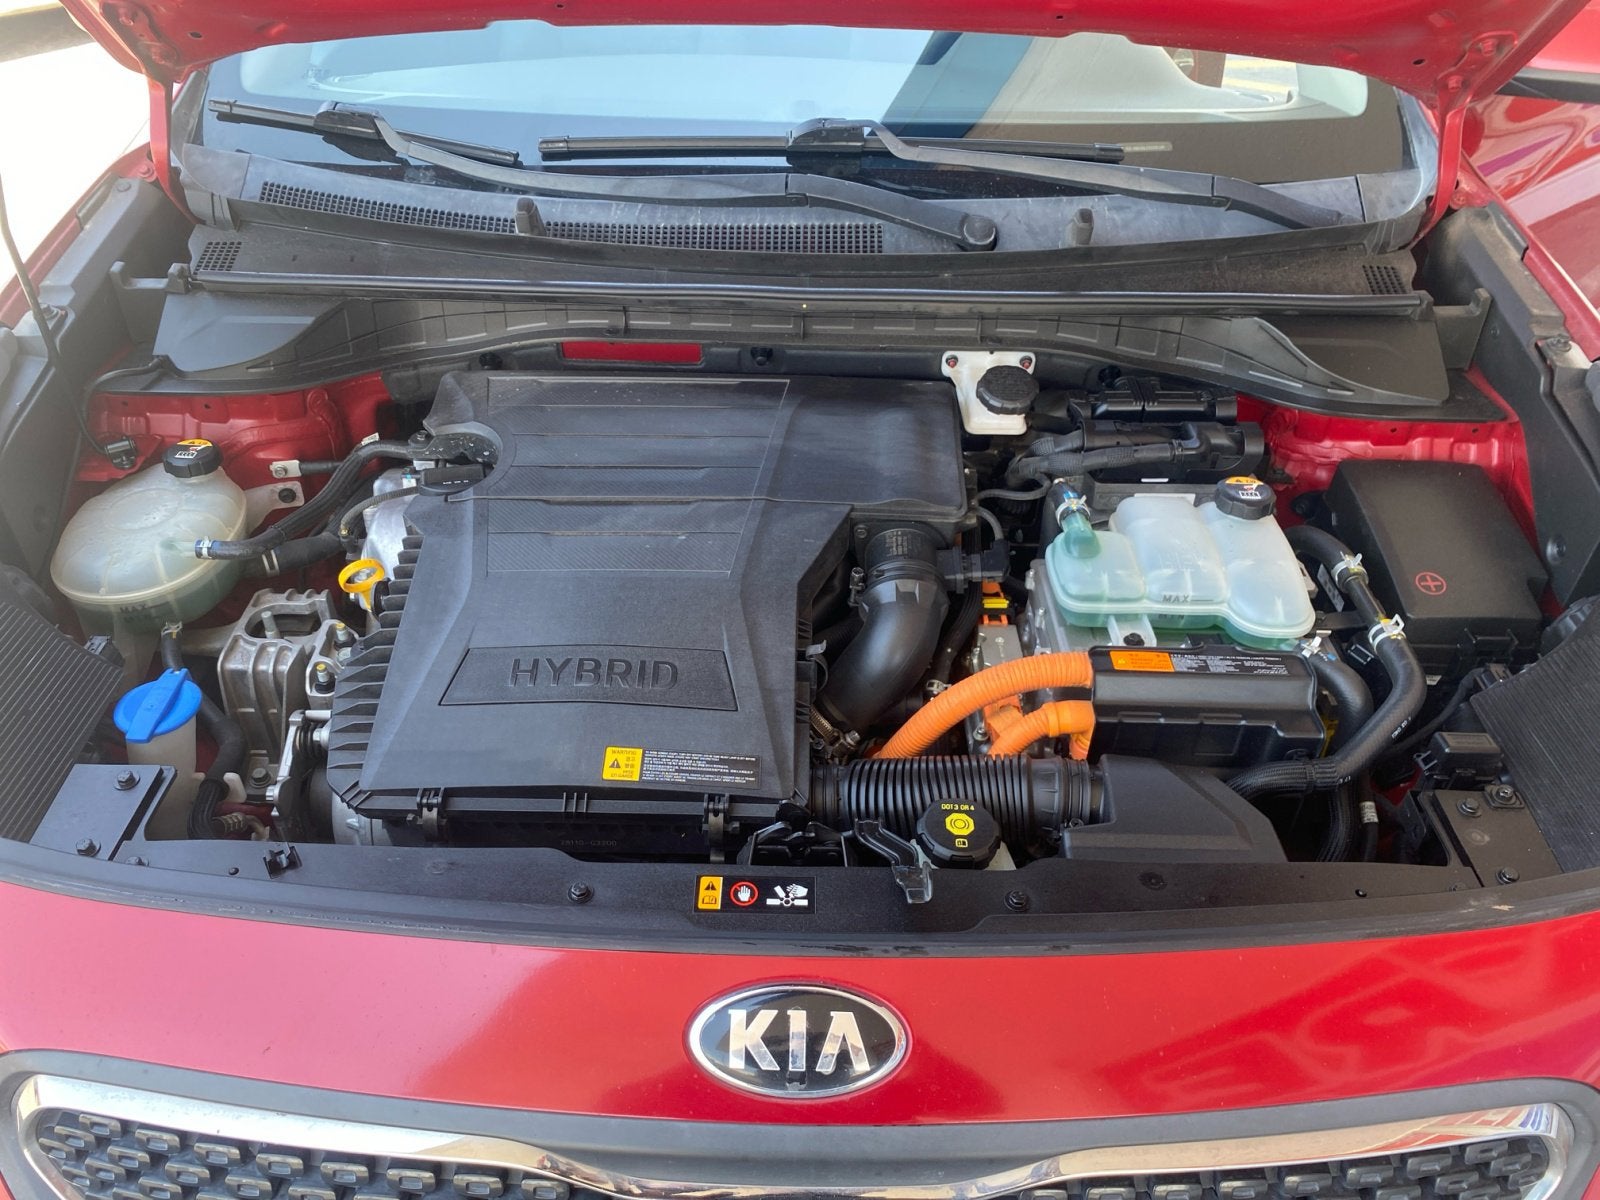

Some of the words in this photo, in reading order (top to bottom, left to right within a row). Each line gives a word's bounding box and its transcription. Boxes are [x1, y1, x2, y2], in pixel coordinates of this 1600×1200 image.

[1162, 594, 1190, 604] MAX
[506, 656, 679, 690] HYBRID
[727, 1009, 871, 1072] KIA
